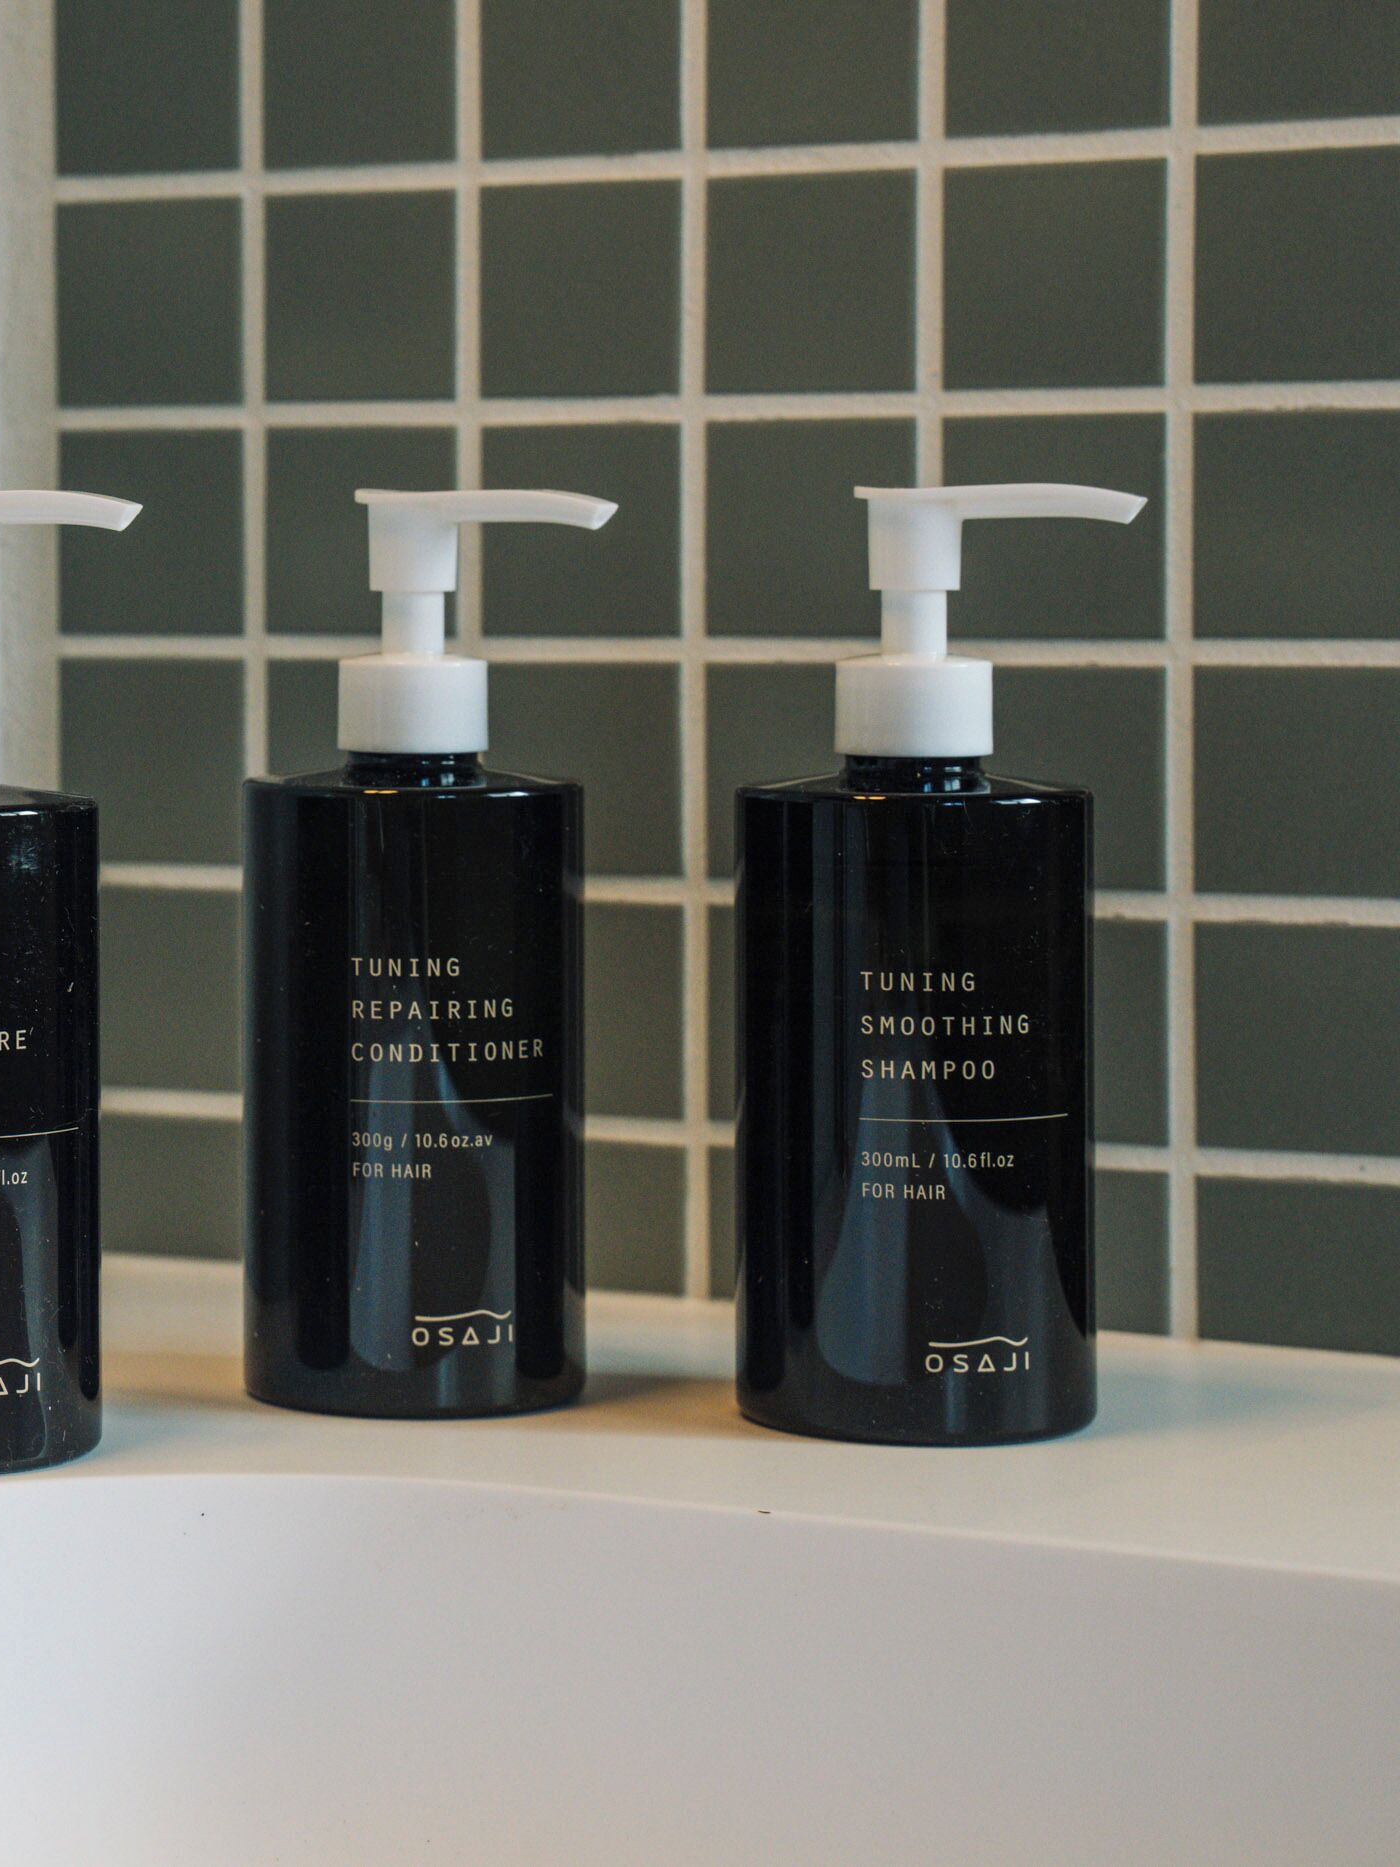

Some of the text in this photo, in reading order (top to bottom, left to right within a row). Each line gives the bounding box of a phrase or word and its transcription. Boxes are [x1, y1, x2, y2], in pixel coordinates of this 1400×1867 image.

[350, 957, 462, 978] TUNING
[860, 971, 977, 992] TUNING
[351, 998, 515, 1020] REPAIRING
[860, 1013, 1031, 1036] SMOOTHING
[350, 1038, 545, 1063] CONDITIONER
[860, 1059, 996, 1081] SHAMPOO
[351, 1131, 394, 1152] 300g
[399, 1133, 408, 1149] /
[352, 1162, 433, 1179] FOR HAIR
[860, 1151, 921, 1169] 300mL
[928, 1152, 936, 1169] /
[861, 1182, 947, 1200] FOR HAIR
[411, 1327, 514, 1347] OSAJI
[924, 1351, 1031, 1373] OSAJI
